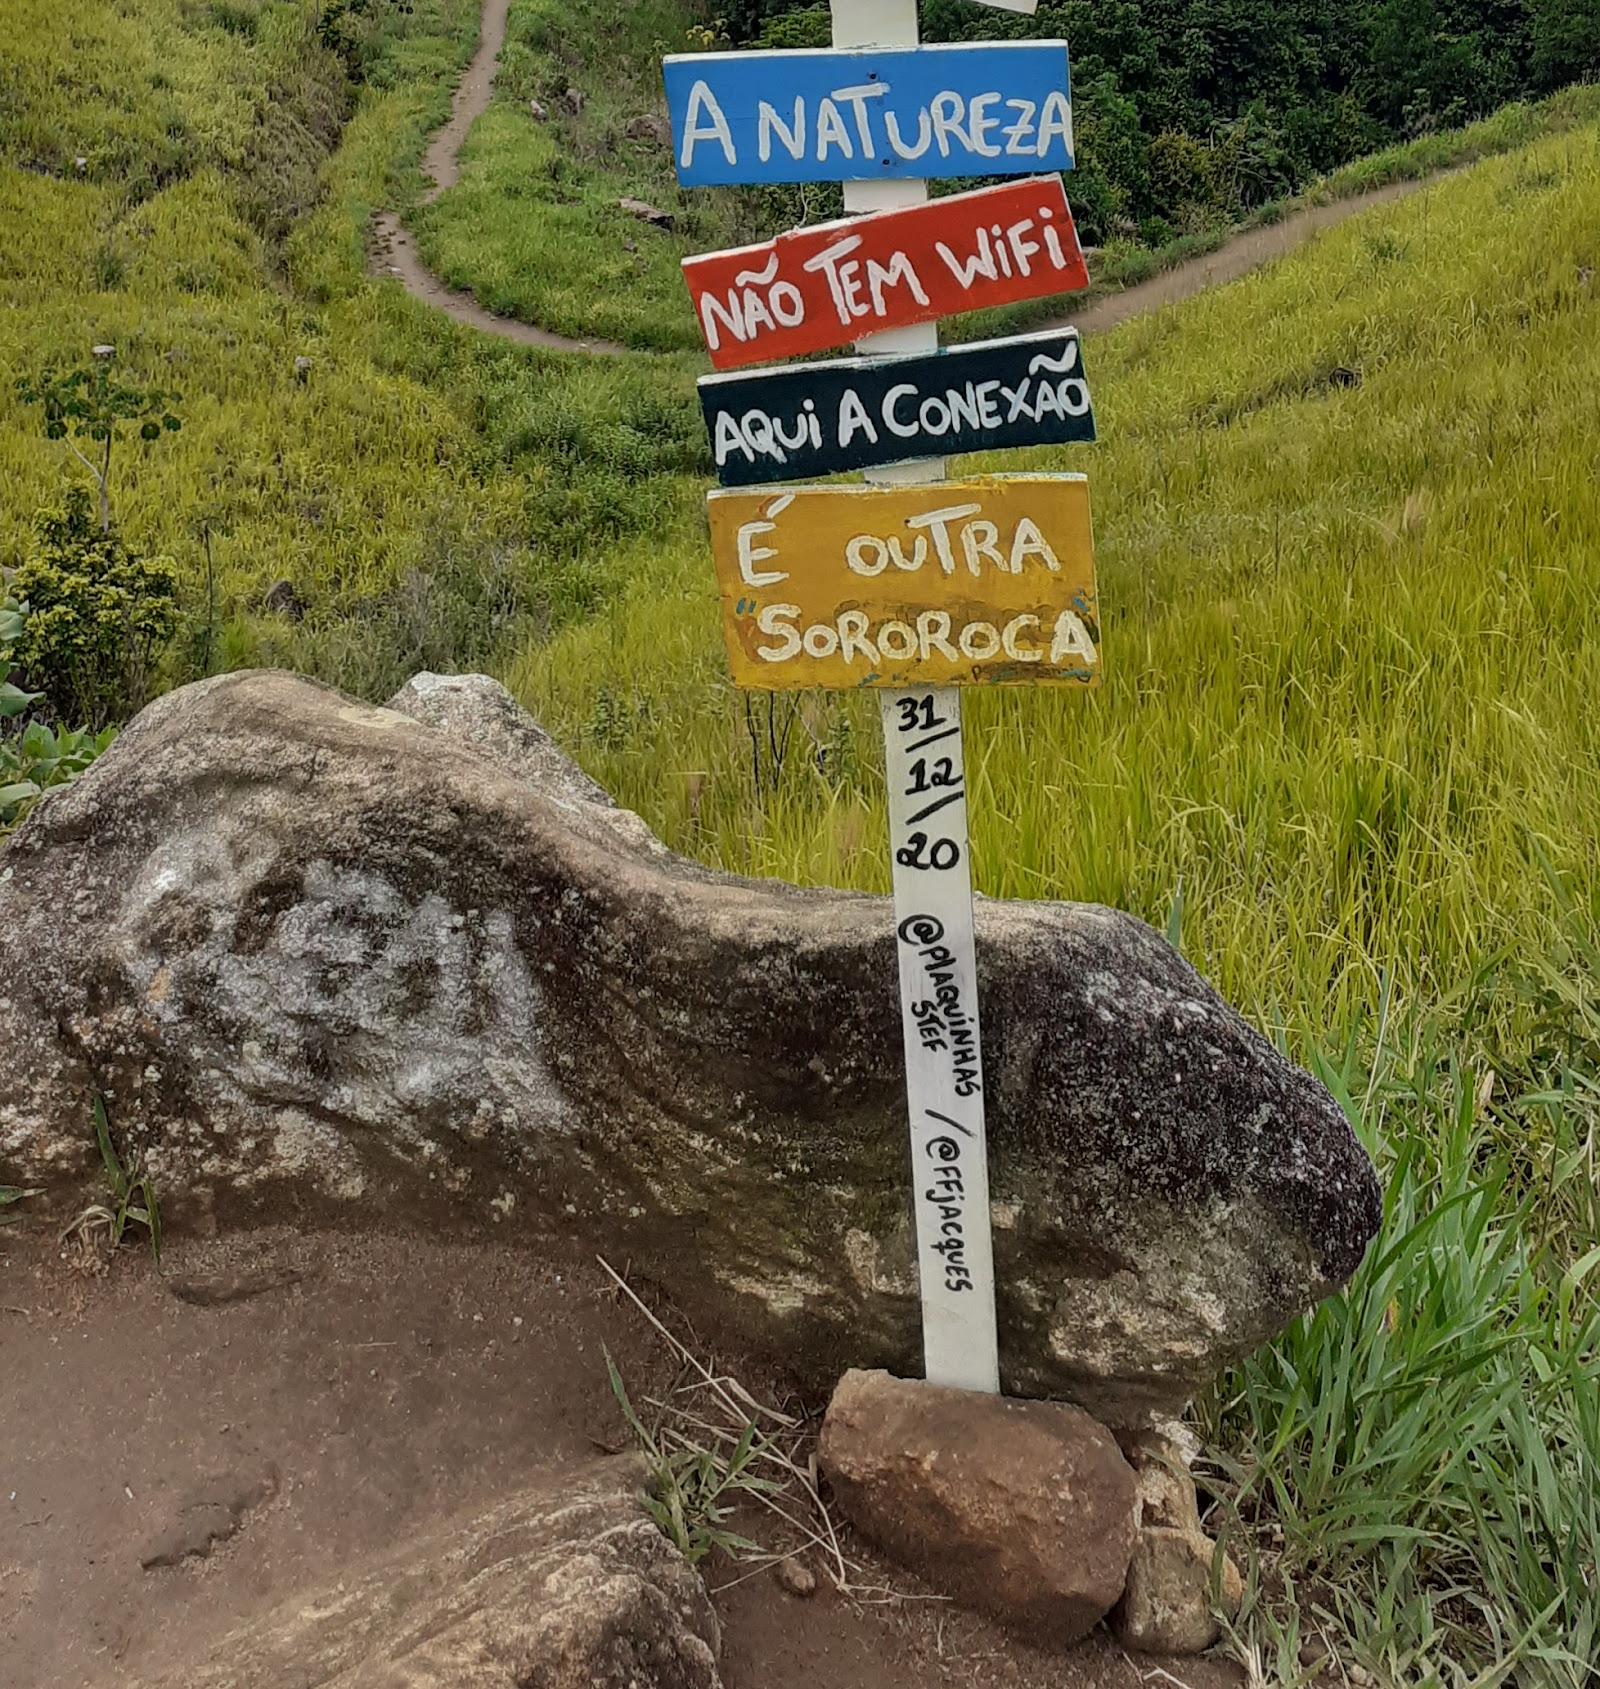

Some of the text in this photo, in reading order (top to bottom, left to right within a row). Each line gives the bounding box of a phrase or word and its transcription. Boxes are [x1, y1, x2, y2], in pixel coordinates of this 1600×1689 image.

[680, 80, 1074, 169] A NATUREZA
[700, 252, 804, 350] NÃO
[803, 234, 930, 326] TEM
[838, 389, 878, 447] A
[881, 341, 1090, 437] CONEXÃO
[737, 495, 1061, 588] É OUTRA
[757, 603, 1098, 665] SOROROCA
[911, 1000, 948, 1052] STEF
